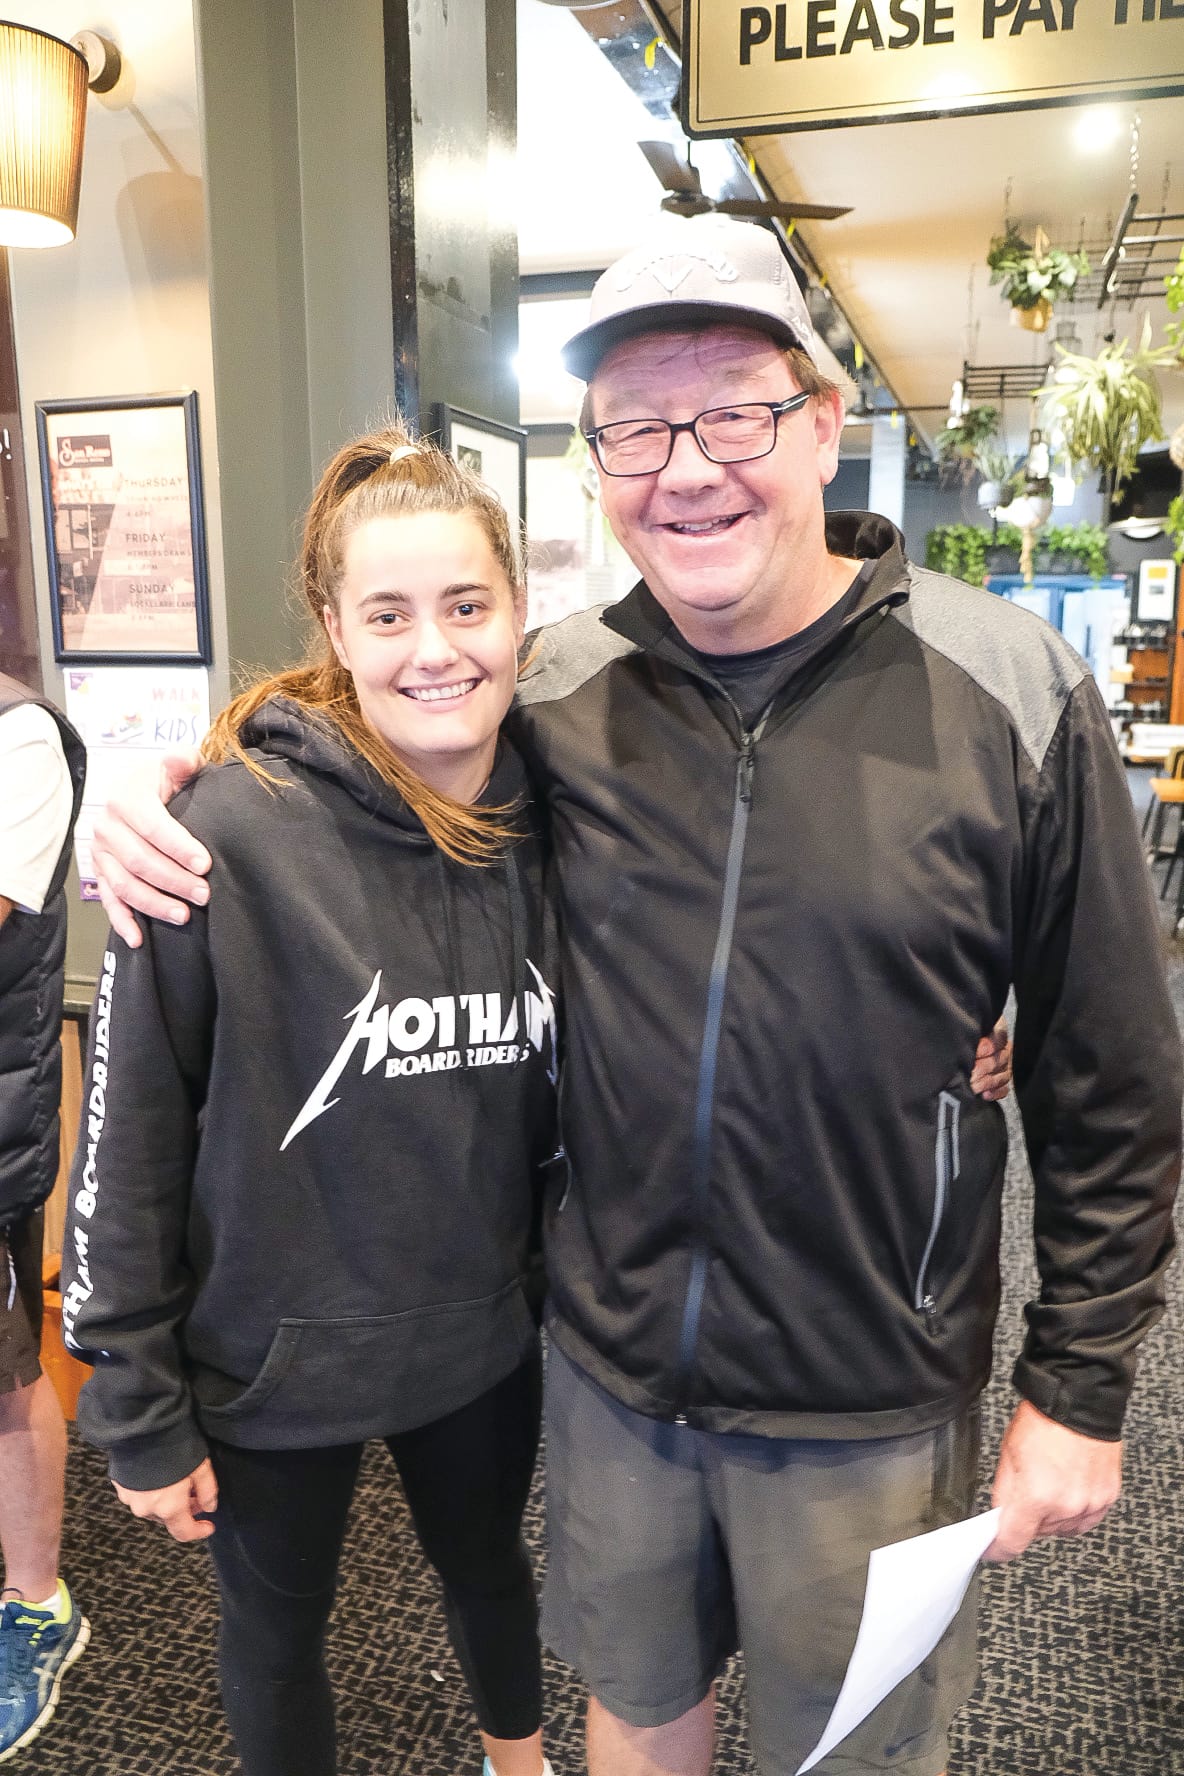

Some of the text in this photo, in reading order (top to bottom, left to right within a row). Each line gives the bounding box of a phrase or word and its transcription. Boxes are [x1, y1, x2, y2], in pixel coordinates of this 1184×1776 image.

[739, 0, 955, 65] PLEASE
[982, 0, 1080, 40] PAY
[124, 477, 183, 488] THURSDAY
[125, 532, 166, 543] FRIDAY
[129, 584, 174, 594] SUNDAY
[154, 716, 198, 745] KIDS
